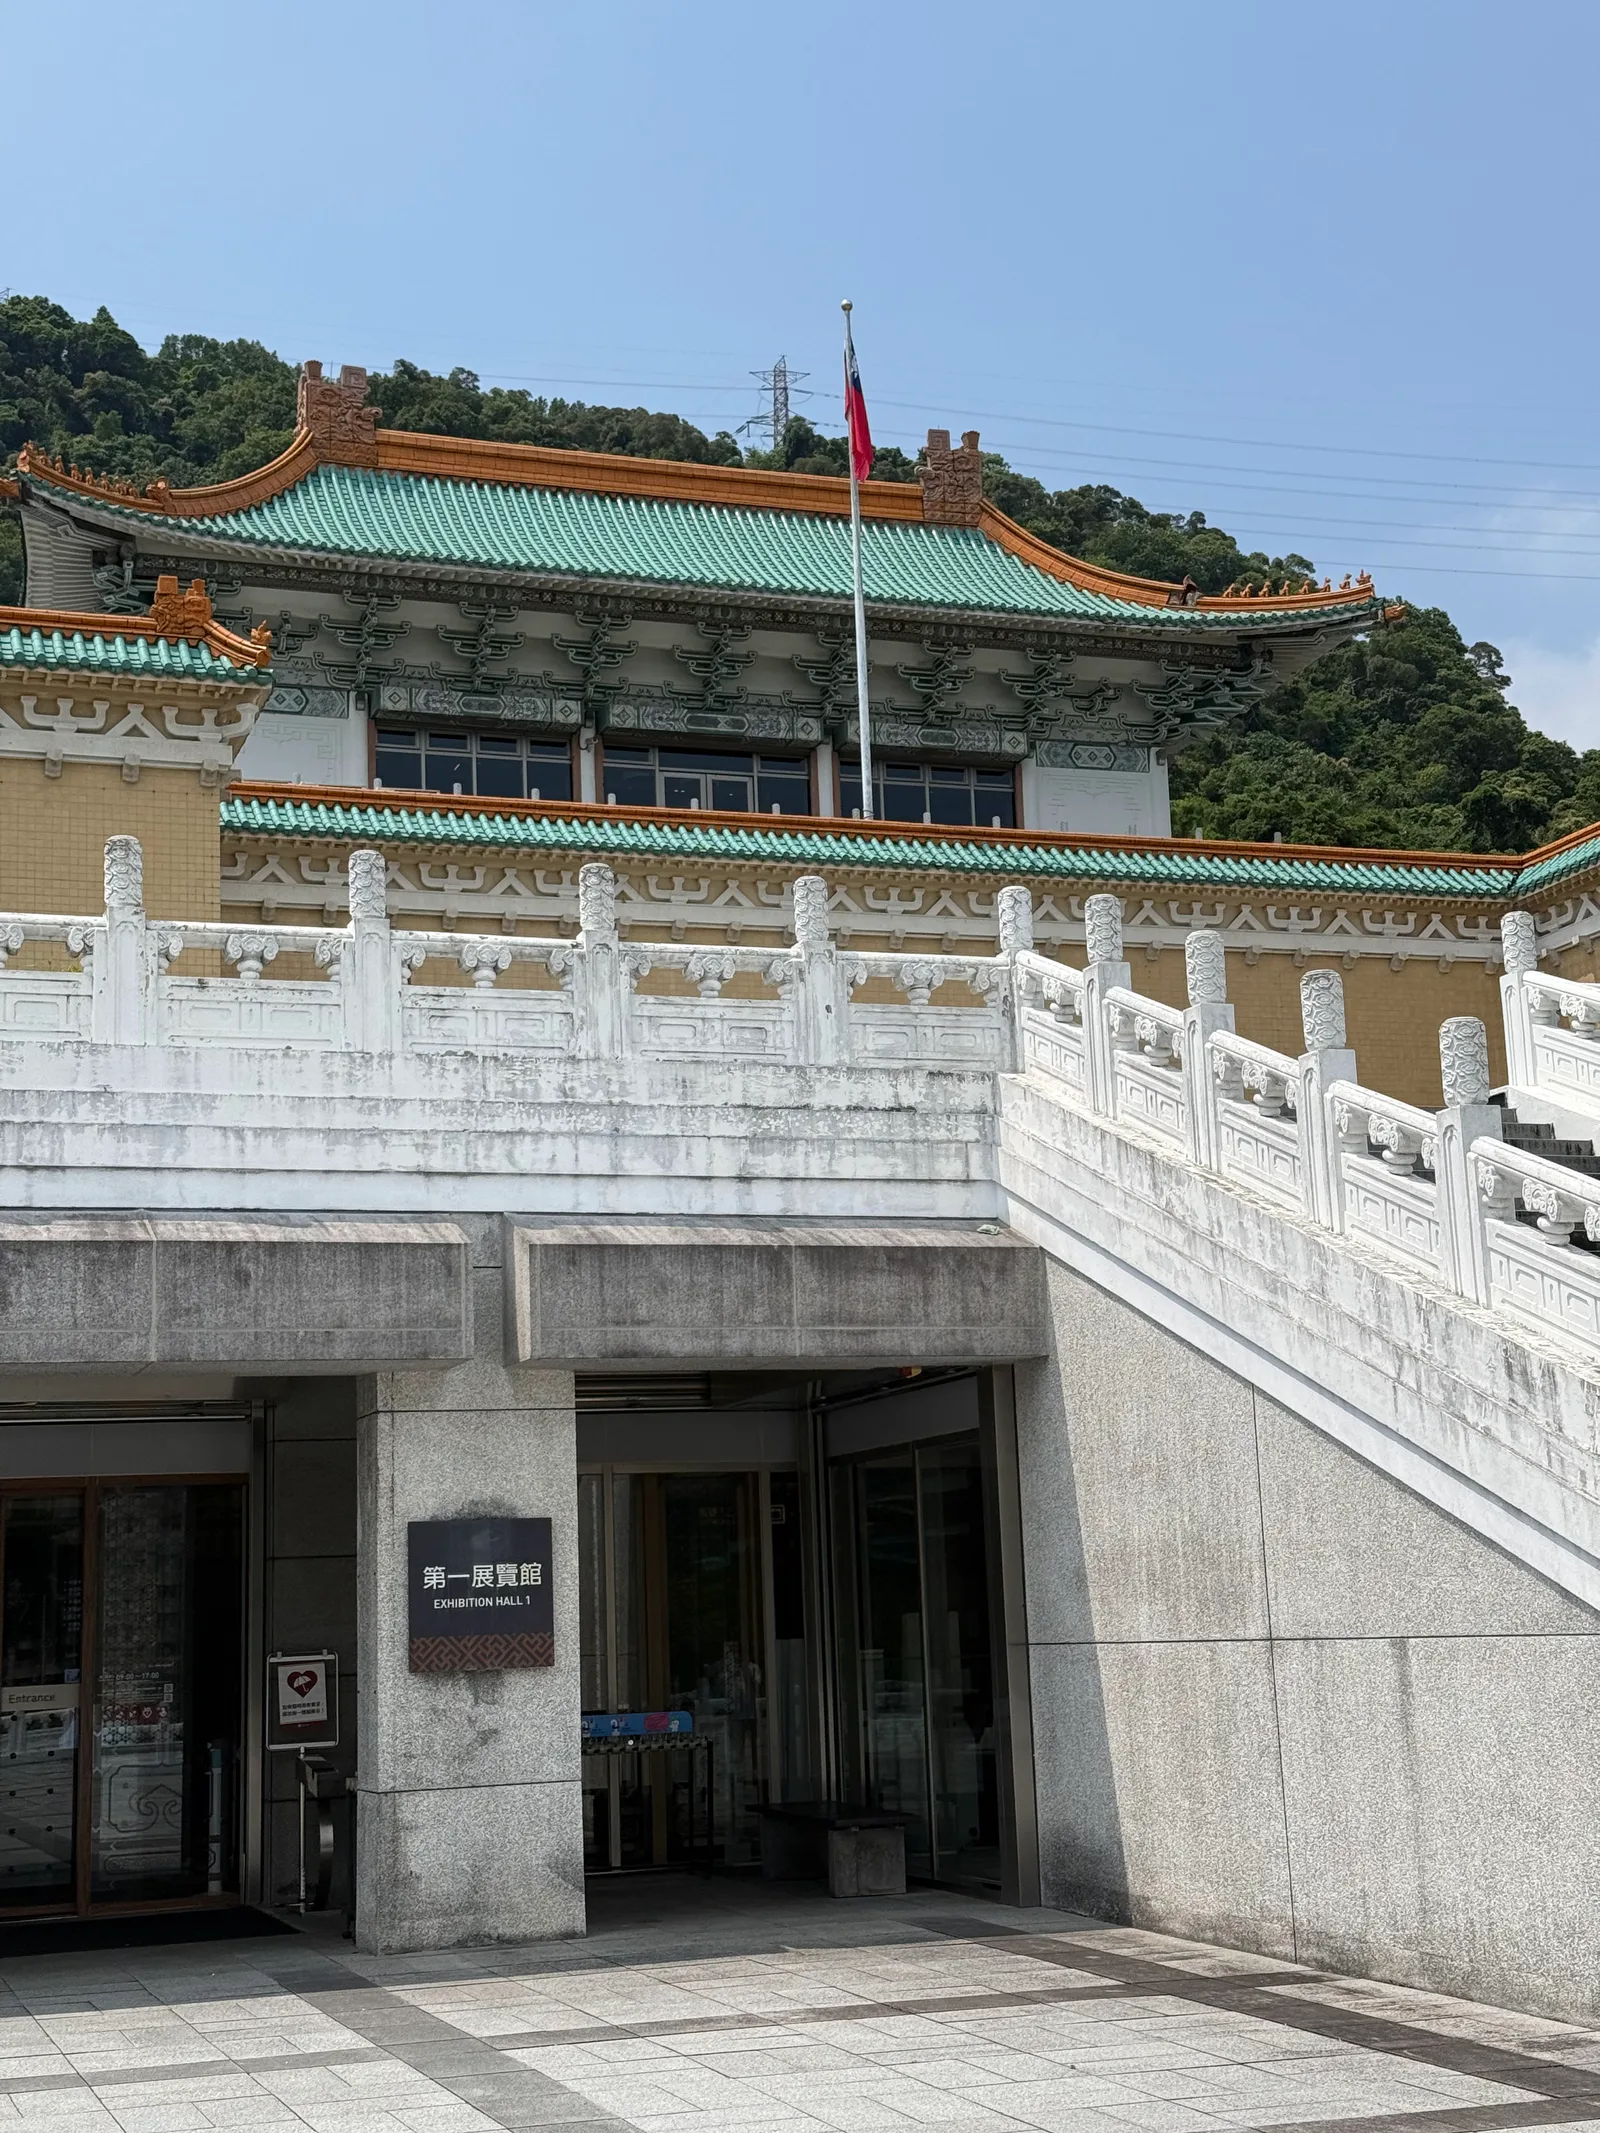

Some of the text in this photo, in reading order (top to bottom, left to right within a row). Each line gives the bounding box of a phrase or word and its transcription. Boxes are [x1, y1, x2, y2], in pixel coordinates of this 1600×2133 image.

[422, 1562, 542, 1590] 第一展覽館
[434, 1595, 531, 1609] EXHIBITION HALL 1
[8, 1693, 56, 1704] Entrance
